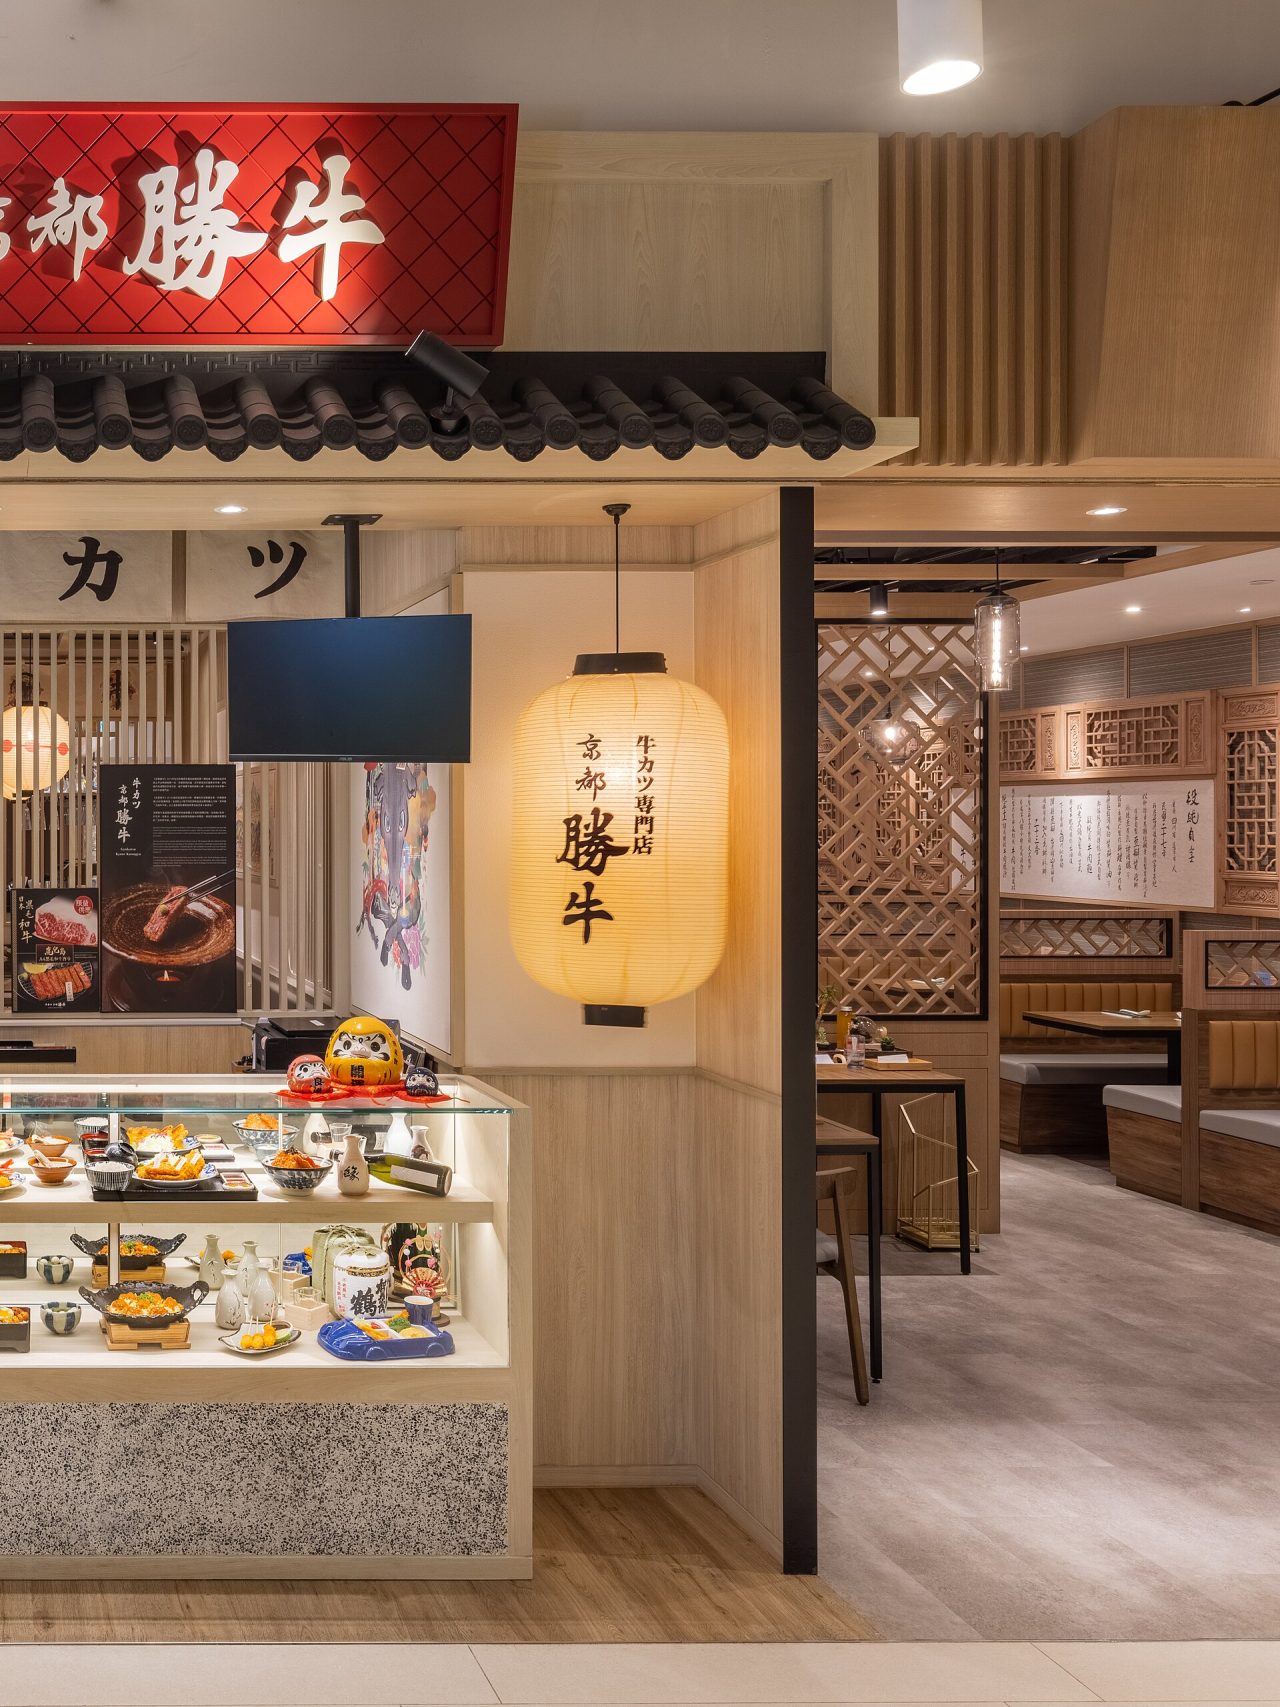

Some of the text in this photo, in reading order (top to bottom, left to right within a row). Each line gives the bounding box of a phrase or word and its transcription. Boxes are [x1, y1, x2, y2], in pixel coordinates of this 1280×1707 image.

[115, 784, 133, 844] 京都勝牛
[132, 777, 142, 809] 牛カツ
[632, 734, 657, 856] 牛カツ専門店
[556, 733, 630, 945] 京都勝牛
